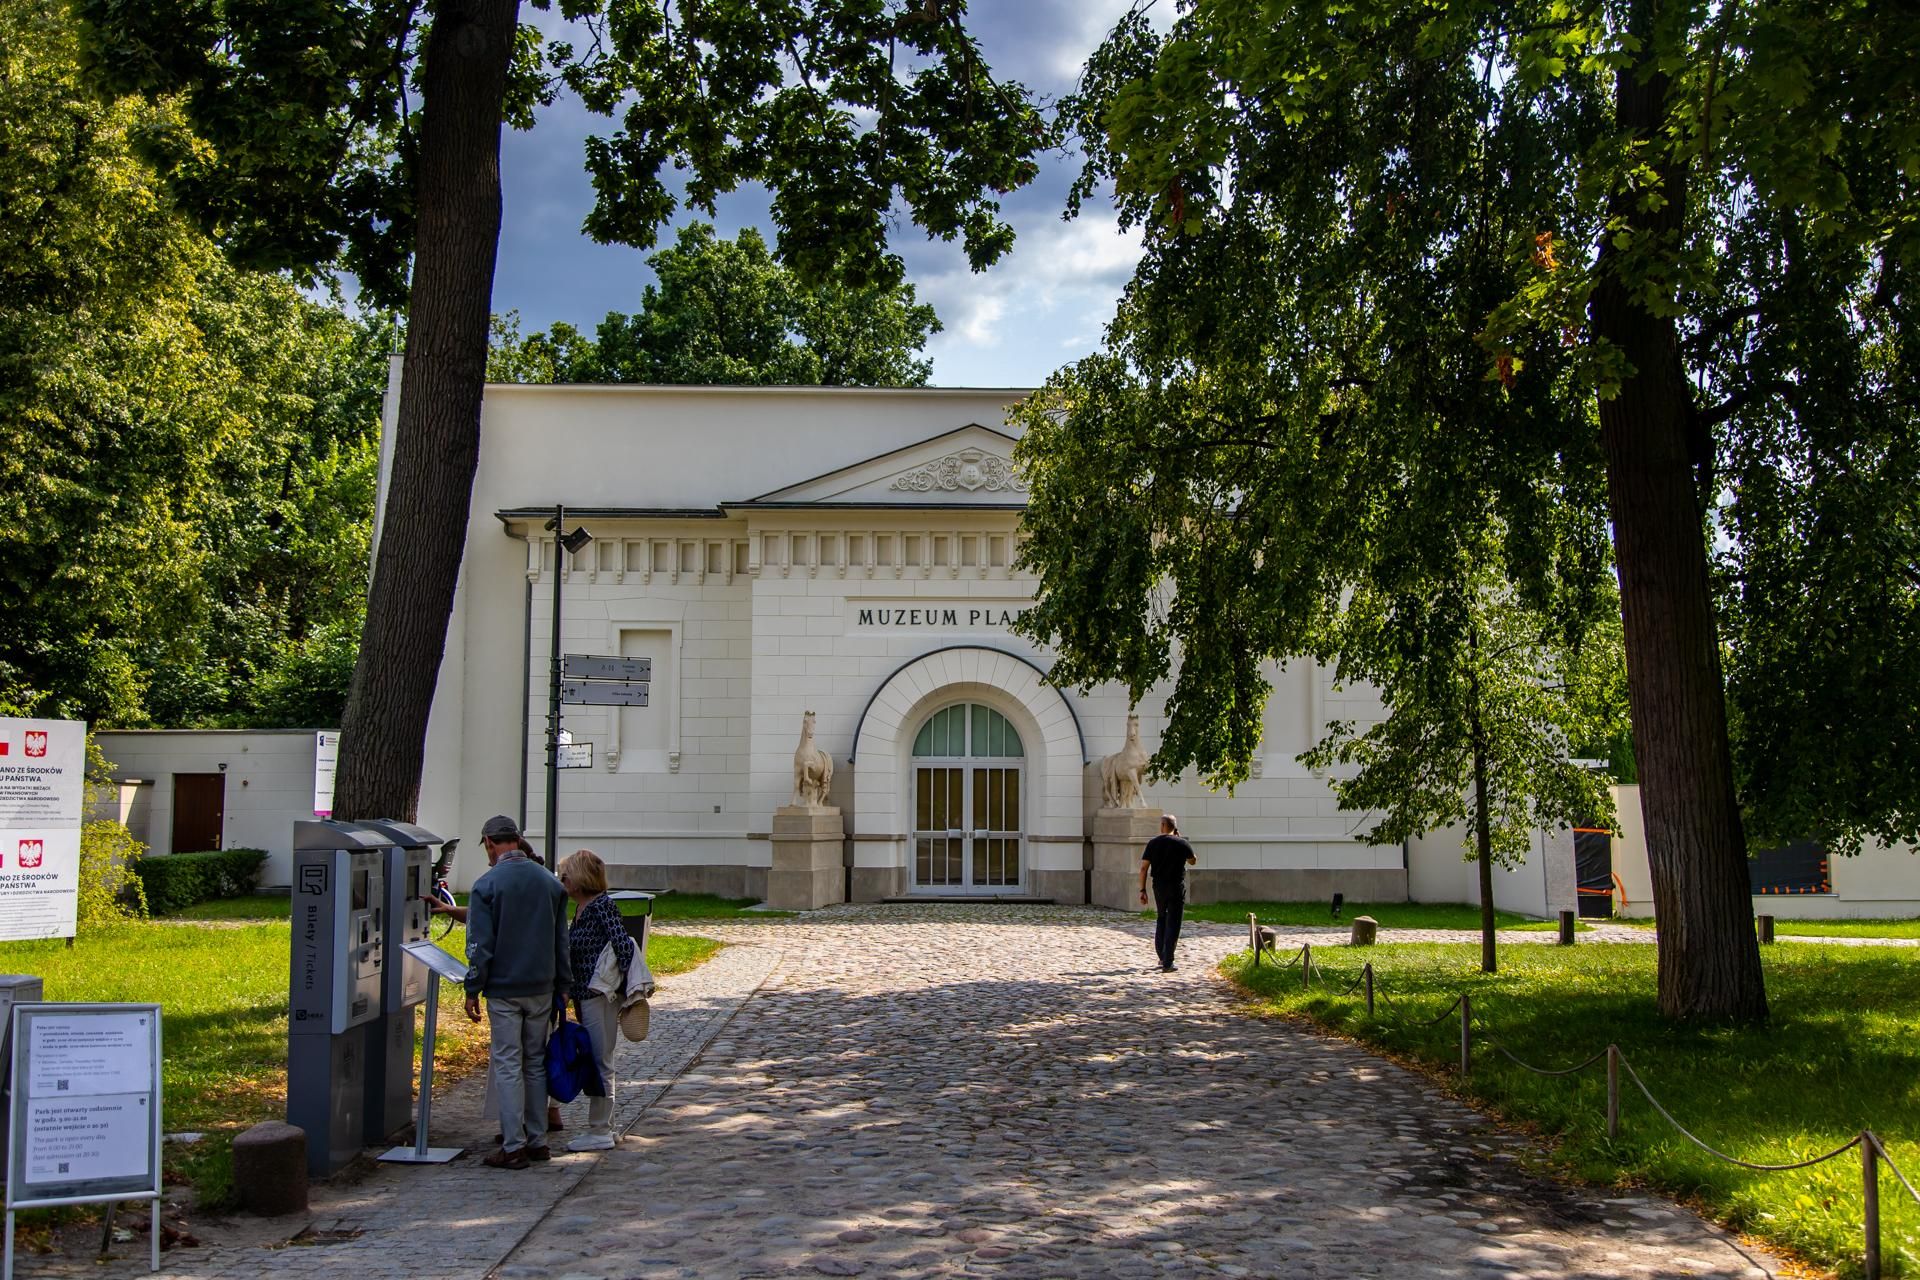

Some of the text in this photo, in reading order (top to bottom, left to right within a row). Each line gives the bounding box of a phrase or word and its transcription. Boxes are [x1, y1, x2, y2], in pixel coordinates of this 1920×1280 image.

[858, 609, 958, 626] MUZEUM
[27, 766, 63, 774] ŚRODKÓW
[5, 774, 42, 782] PAŃSTWA
[0, 881, 37, 889] PAŃSTWA
[304, 904, 318, 942] Bilety
[305, 952, 317, 991] Tickets
